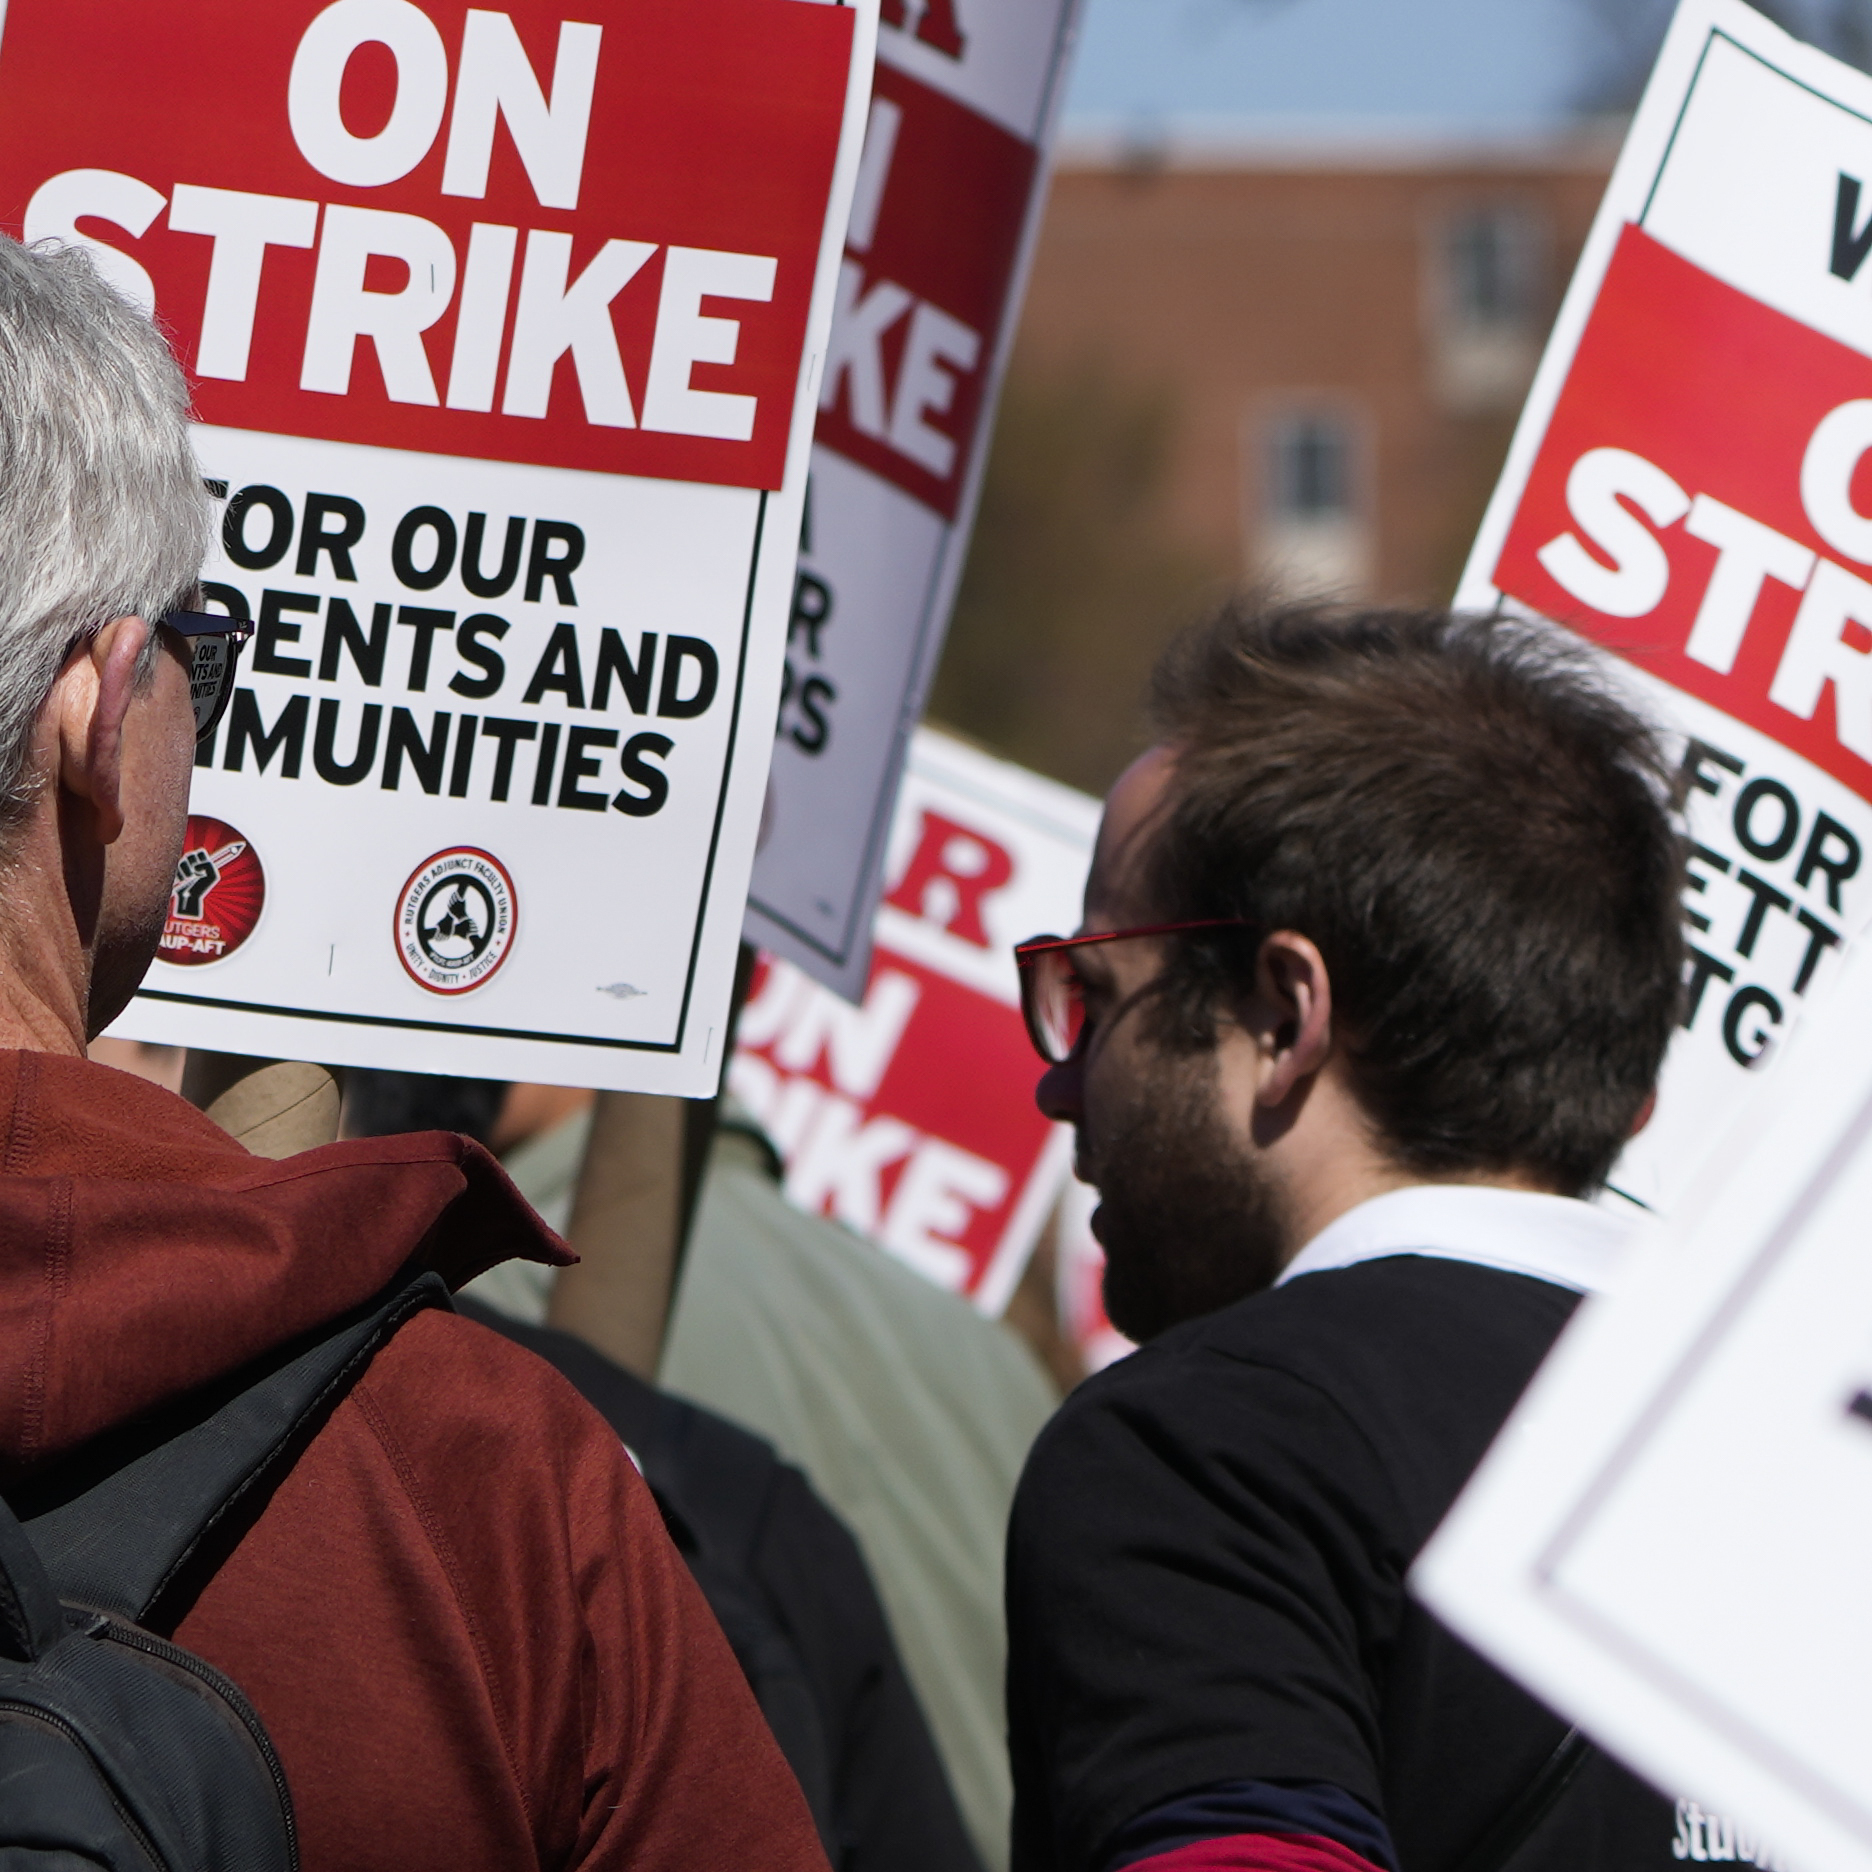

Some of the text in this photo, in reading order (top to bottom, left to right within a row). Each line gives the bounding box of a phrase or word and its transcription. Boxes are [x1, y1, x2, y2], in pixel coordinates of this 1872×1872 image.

[23, 168, 779, 443] STRIKE
[391, 505, 586, 607] OUR
[1537, 446, 1872, 768] STR
[521, 622, 720, 719] AND
[405, 858, 508, 934] RUTGERS ADJUNCT FACULTY UNION
[882, 806, 1013, 952] R
[159, 936, 226, 955] AUP-AFT
[164, 921, 220, 939] UTGERS
[406, 942, 425, 969] UNITY
